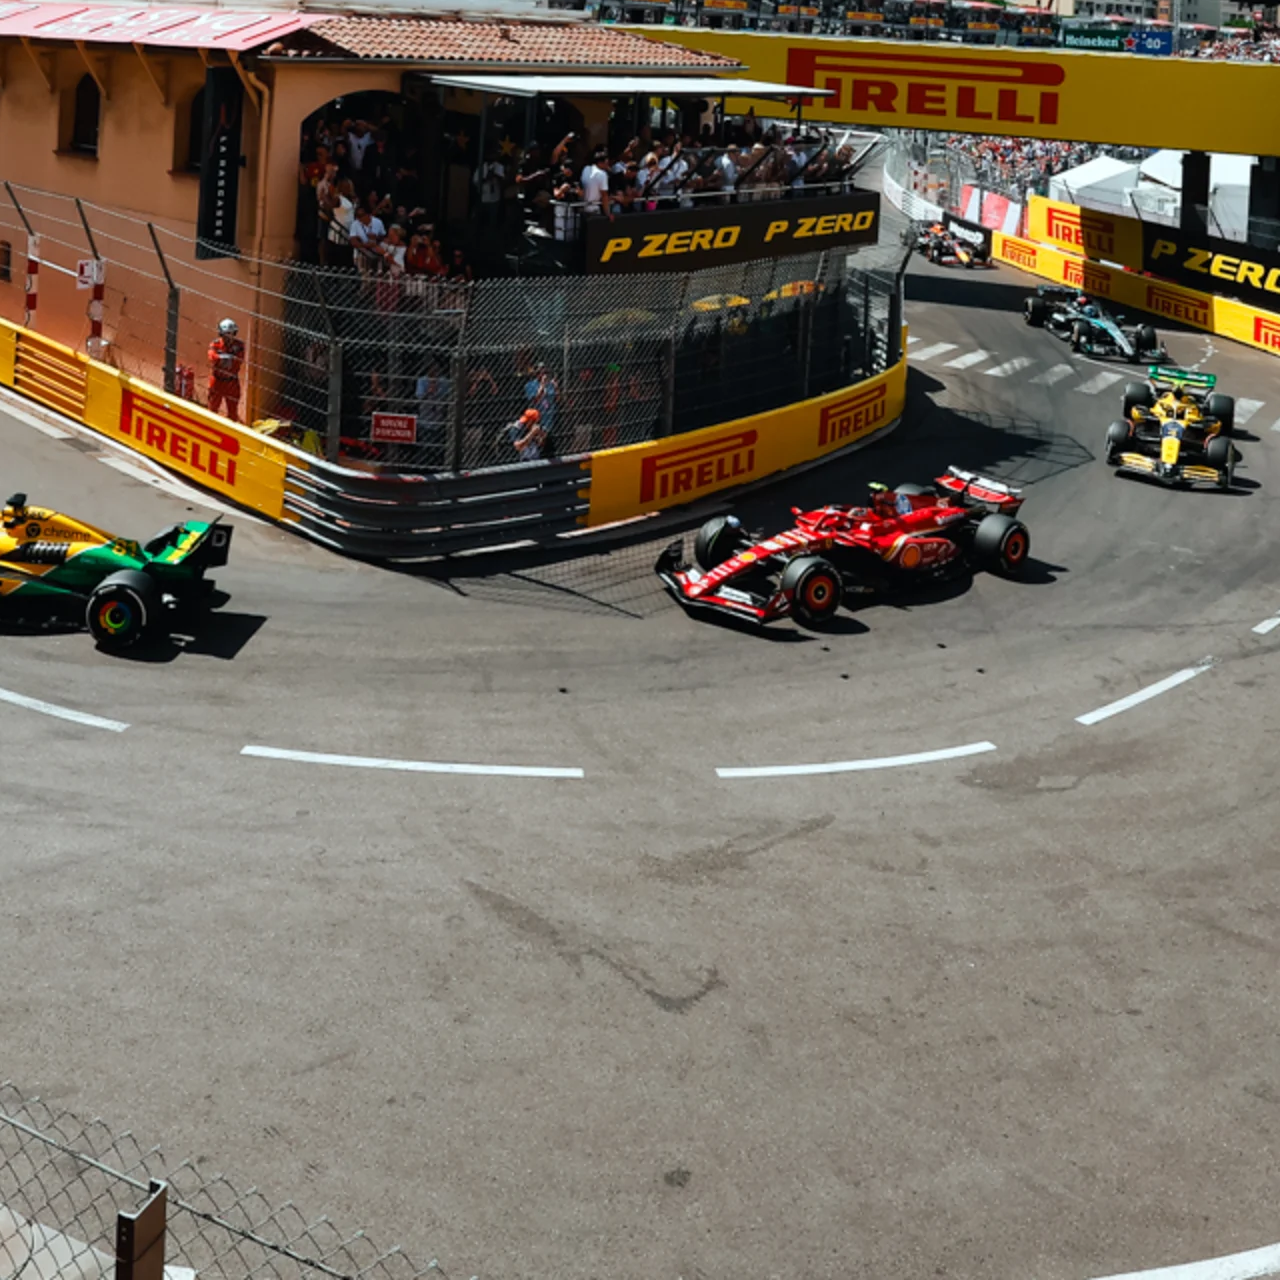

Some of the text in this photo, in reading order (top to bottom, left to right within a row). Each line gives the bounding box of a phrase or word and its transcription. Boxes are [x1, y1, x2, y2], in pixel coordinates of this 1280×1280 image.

[72, 7, 273, 30] CASINO
[1065, 33, 1118, 48] Heineken
[786, 48, 1065, 125] PIRELLI
[600, 211, 875, 263] P ZERO P ZERO
[1001, 238, 1037, 269] PIRELLI
[1046, 207, 1115, 256] PIRELLI
[1150, 238, 1177, 261] P
[1063, 259, 1111, 296] PIRELLI
[1146, 283, 1210, 332] PIRELLI
[120, 388, 240, 486] PIRELLI
[819, 384, 887, 447] PIRELLI
[640, 429, 759, 503] PIRELLI
[43, 525, 91, 541] chrome
